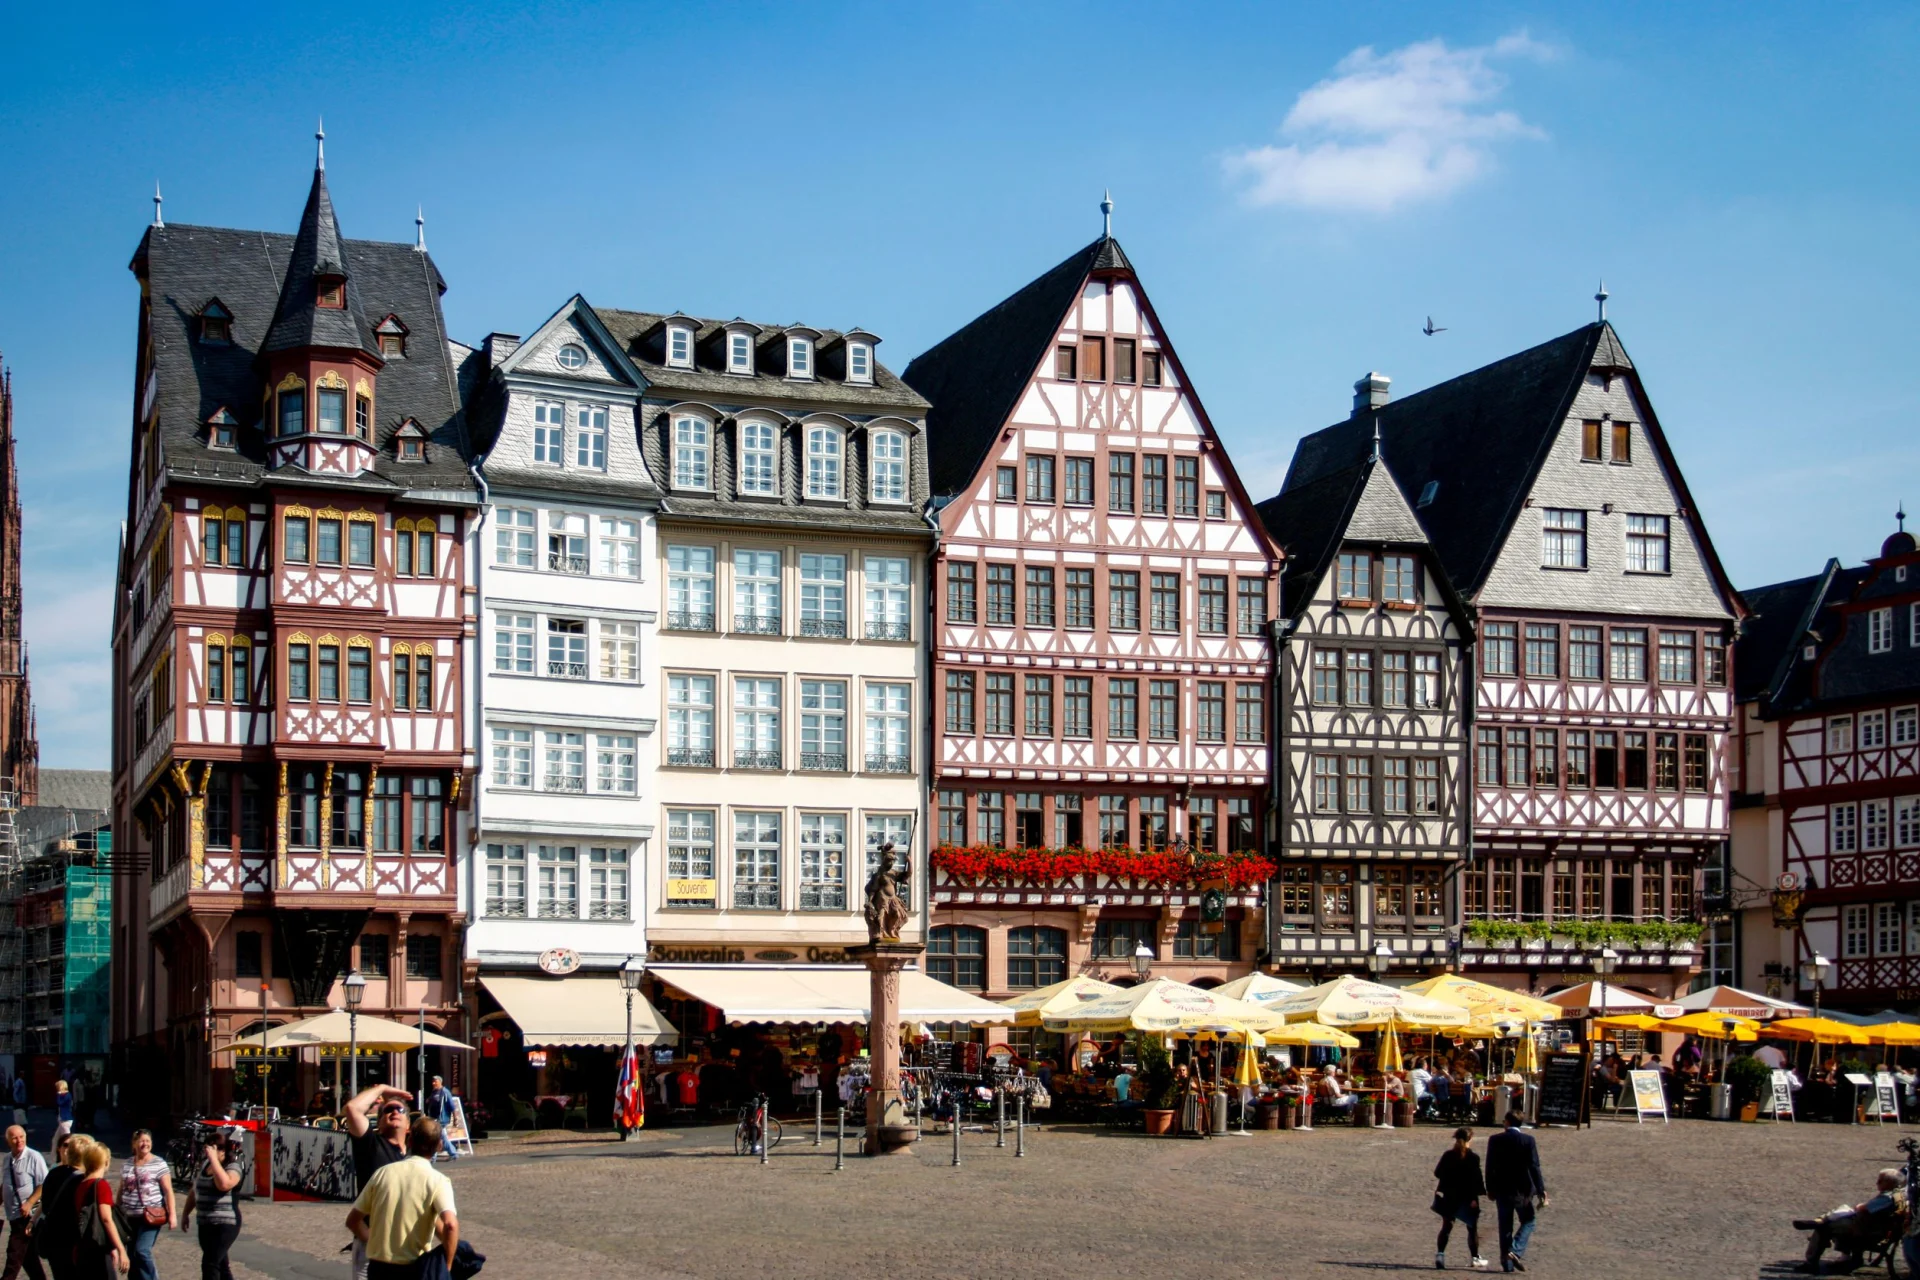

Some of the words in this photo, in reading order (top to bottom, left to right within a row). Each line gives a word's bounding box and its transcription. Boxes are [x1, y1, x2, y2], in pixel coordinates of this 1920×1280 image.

[676, 881, 708, 895] Souvenirs
[654, 945, 745, 962] Souvenirs
[1896, 989, 1920, 1000] RES
[1728, 1008, 1767, 1017] Henninger
